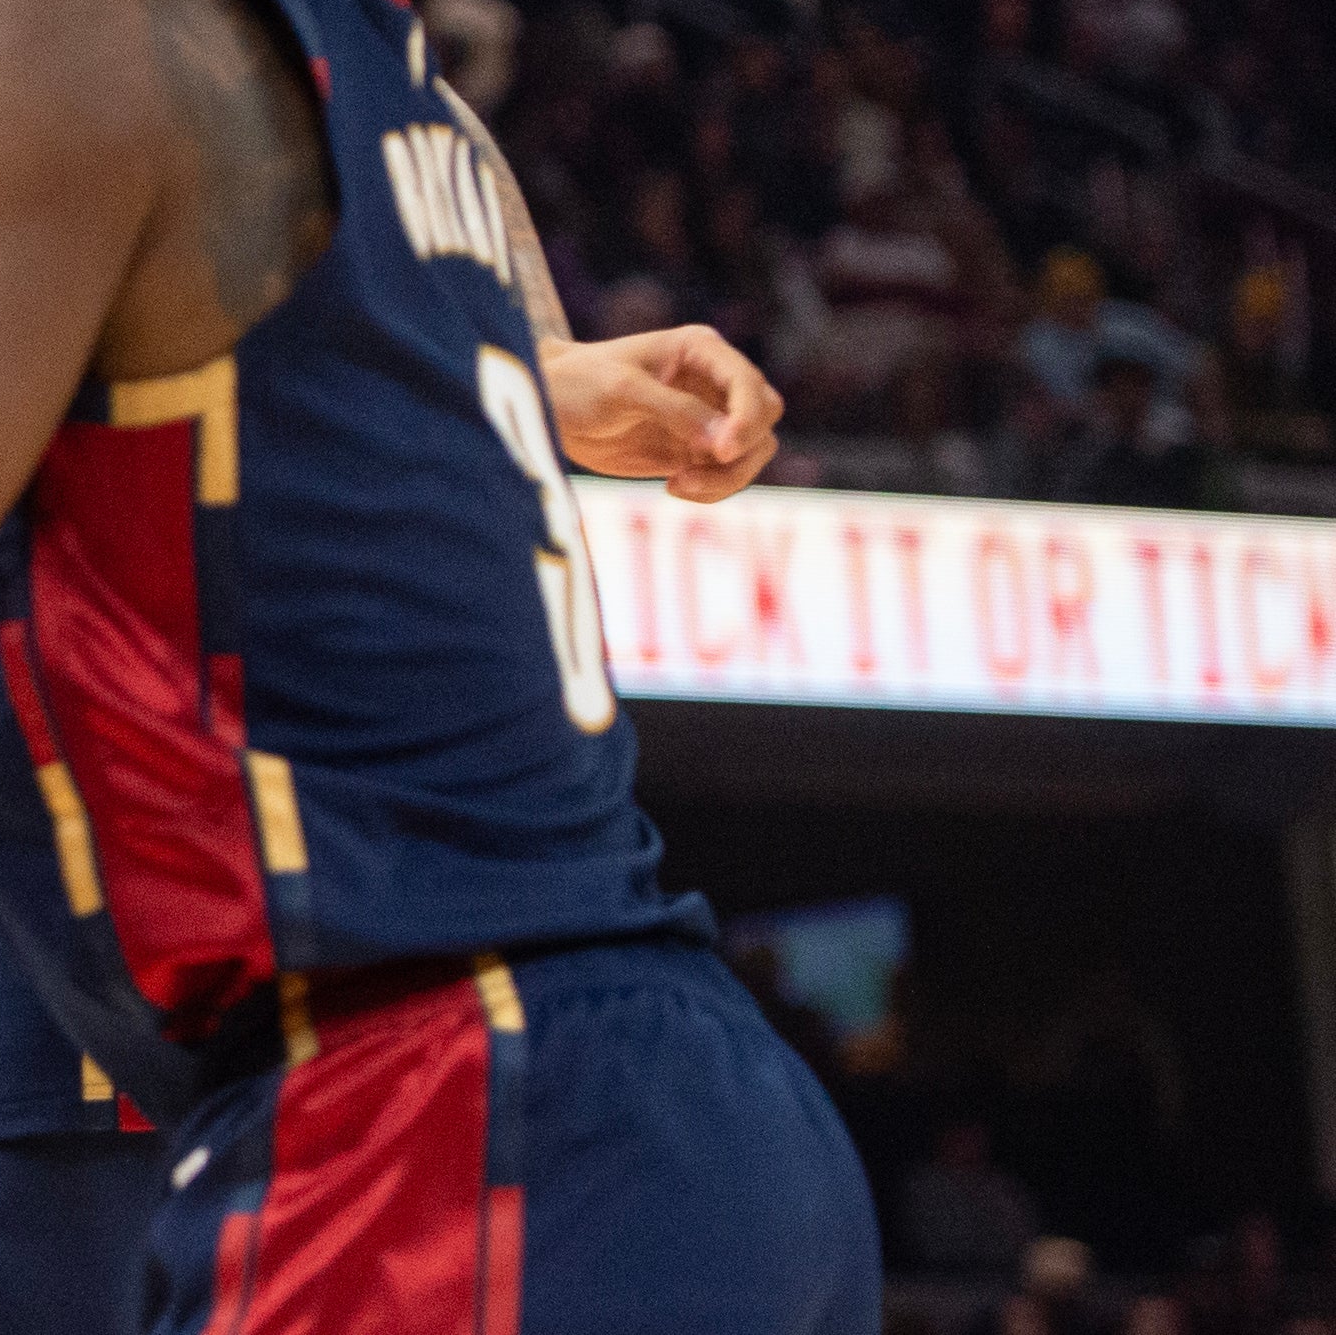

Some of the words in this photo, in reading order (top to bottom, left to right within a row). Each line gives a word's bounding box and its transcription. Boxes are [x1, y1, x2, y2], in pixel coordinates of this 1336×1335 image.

[611, 512, 809, 669] ICK
[839, 522, 931, 676] IT
[971, 532, 1104, 682] OR
